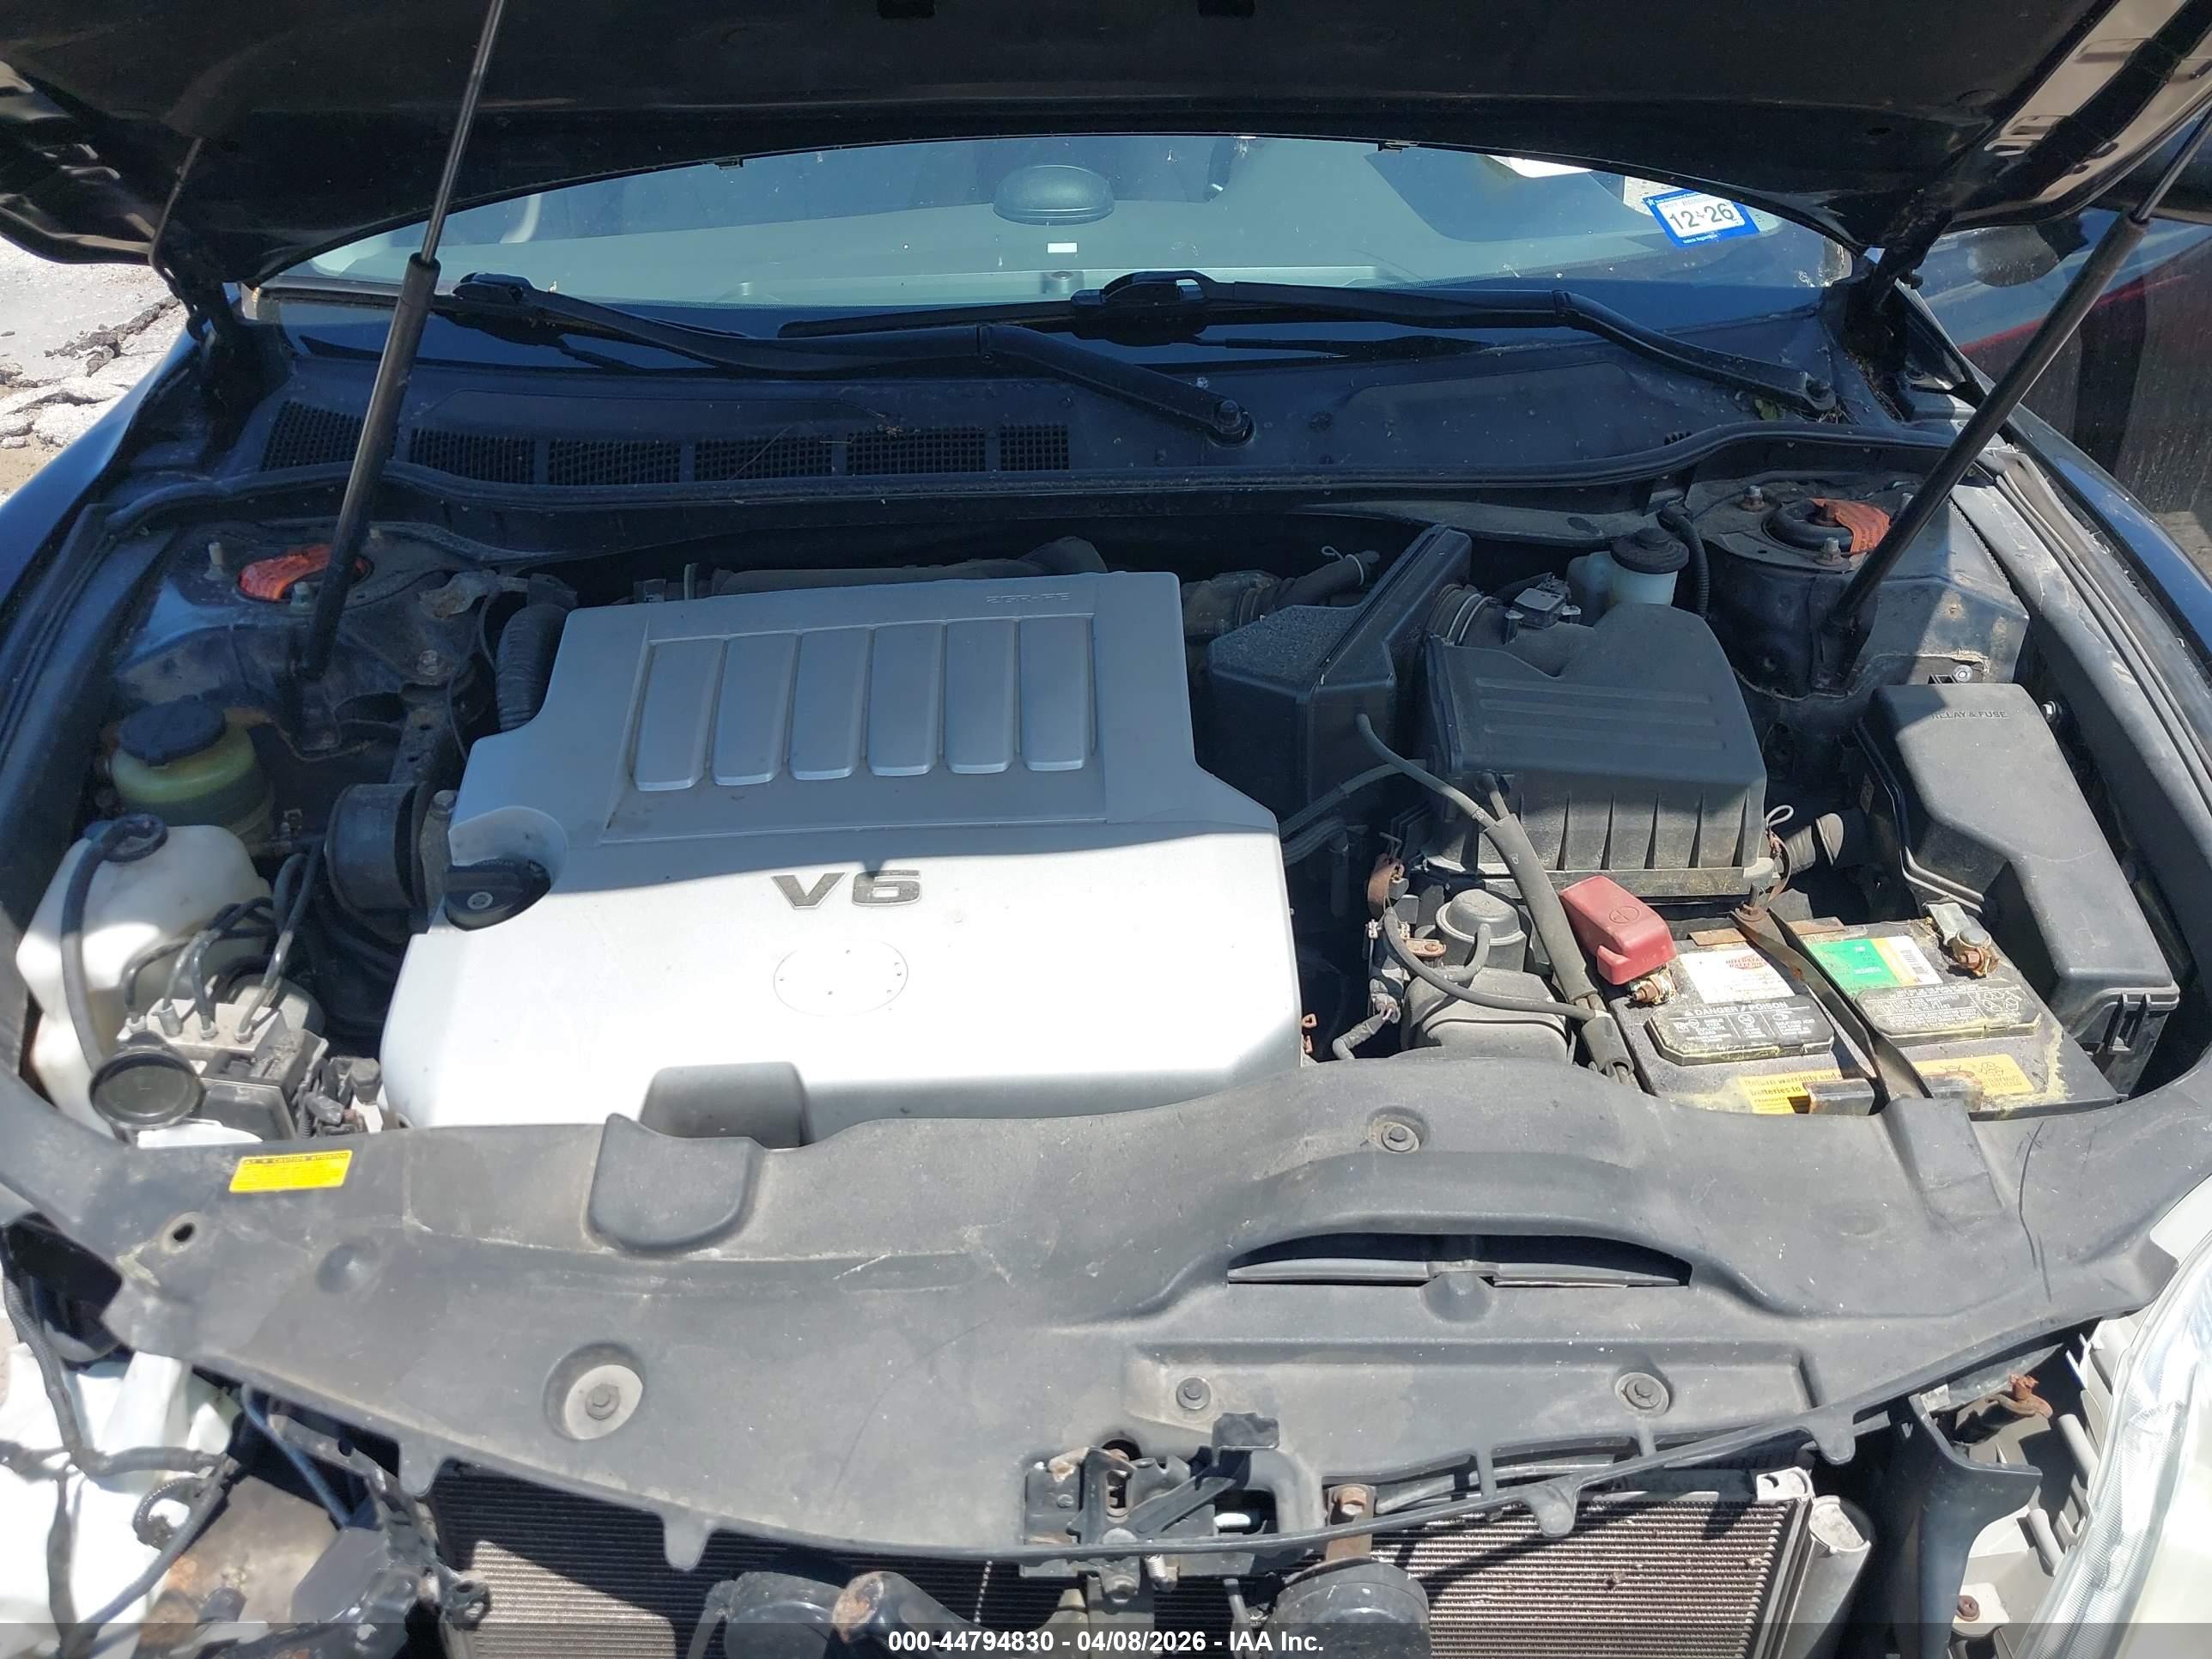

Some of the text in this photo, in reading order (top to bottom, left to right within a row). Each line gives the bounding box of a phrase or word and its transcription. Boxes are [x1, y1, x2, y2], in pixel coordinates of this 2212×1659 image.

[1669, 210, 1700, 230] 12
[1704, 203, 1735, 223] 26
[1930, 711, 1966, 720] RELAY
[1978, 710, 2008, 719] FUSE
[770, 868, 922, 910] V6
[1695, 1006, 1737, 1017] DANGER
[1749, 1001, 1789, 1011] POISON
[1820, 1072, 1837, 1080] and
